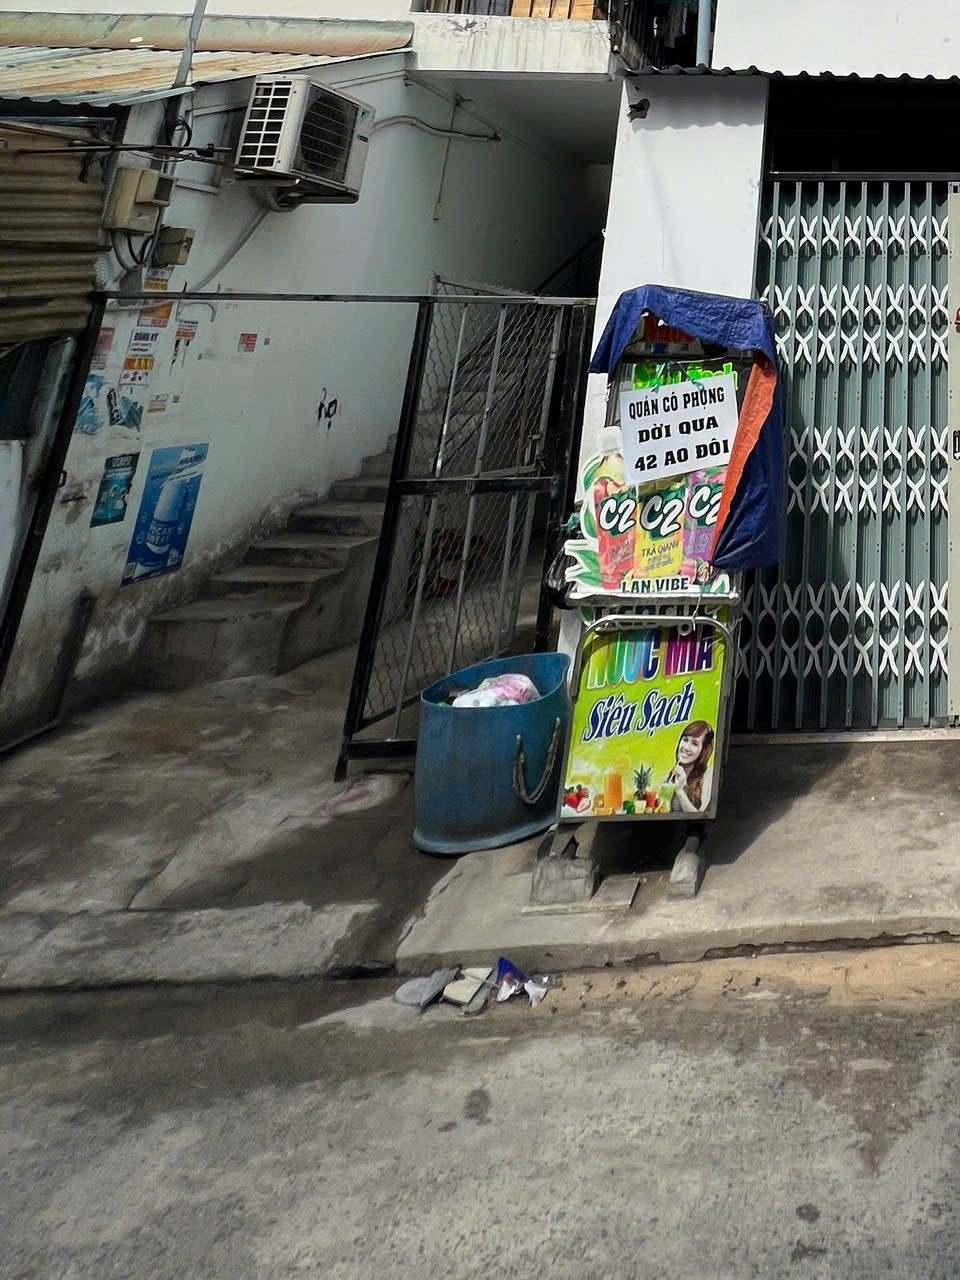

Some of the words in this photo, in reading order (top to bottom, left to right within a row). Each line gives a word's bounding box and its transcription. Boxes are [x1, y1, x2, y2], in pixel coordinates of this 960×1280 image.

[628, 395, 659, 420] QUÁN
[682, 387, 725, 410] PHỤNG
[637, 423, 672, 443] DỜI
[678, 416, 719, 435] QUA
[634, 454, 658, 472] 42
[664, 448, 689, 467] AO
[695, 438, 730, 459] ĐÔI
[599, 498, 636, 533] C2
[640, 495, 684, 537] C2
[622, 579, 651, 593] LAN
[655, 578, 689, 591] VIBE
[581, 693, 636, 743] Siêu
[636, 681, 696, 737] Sạch
